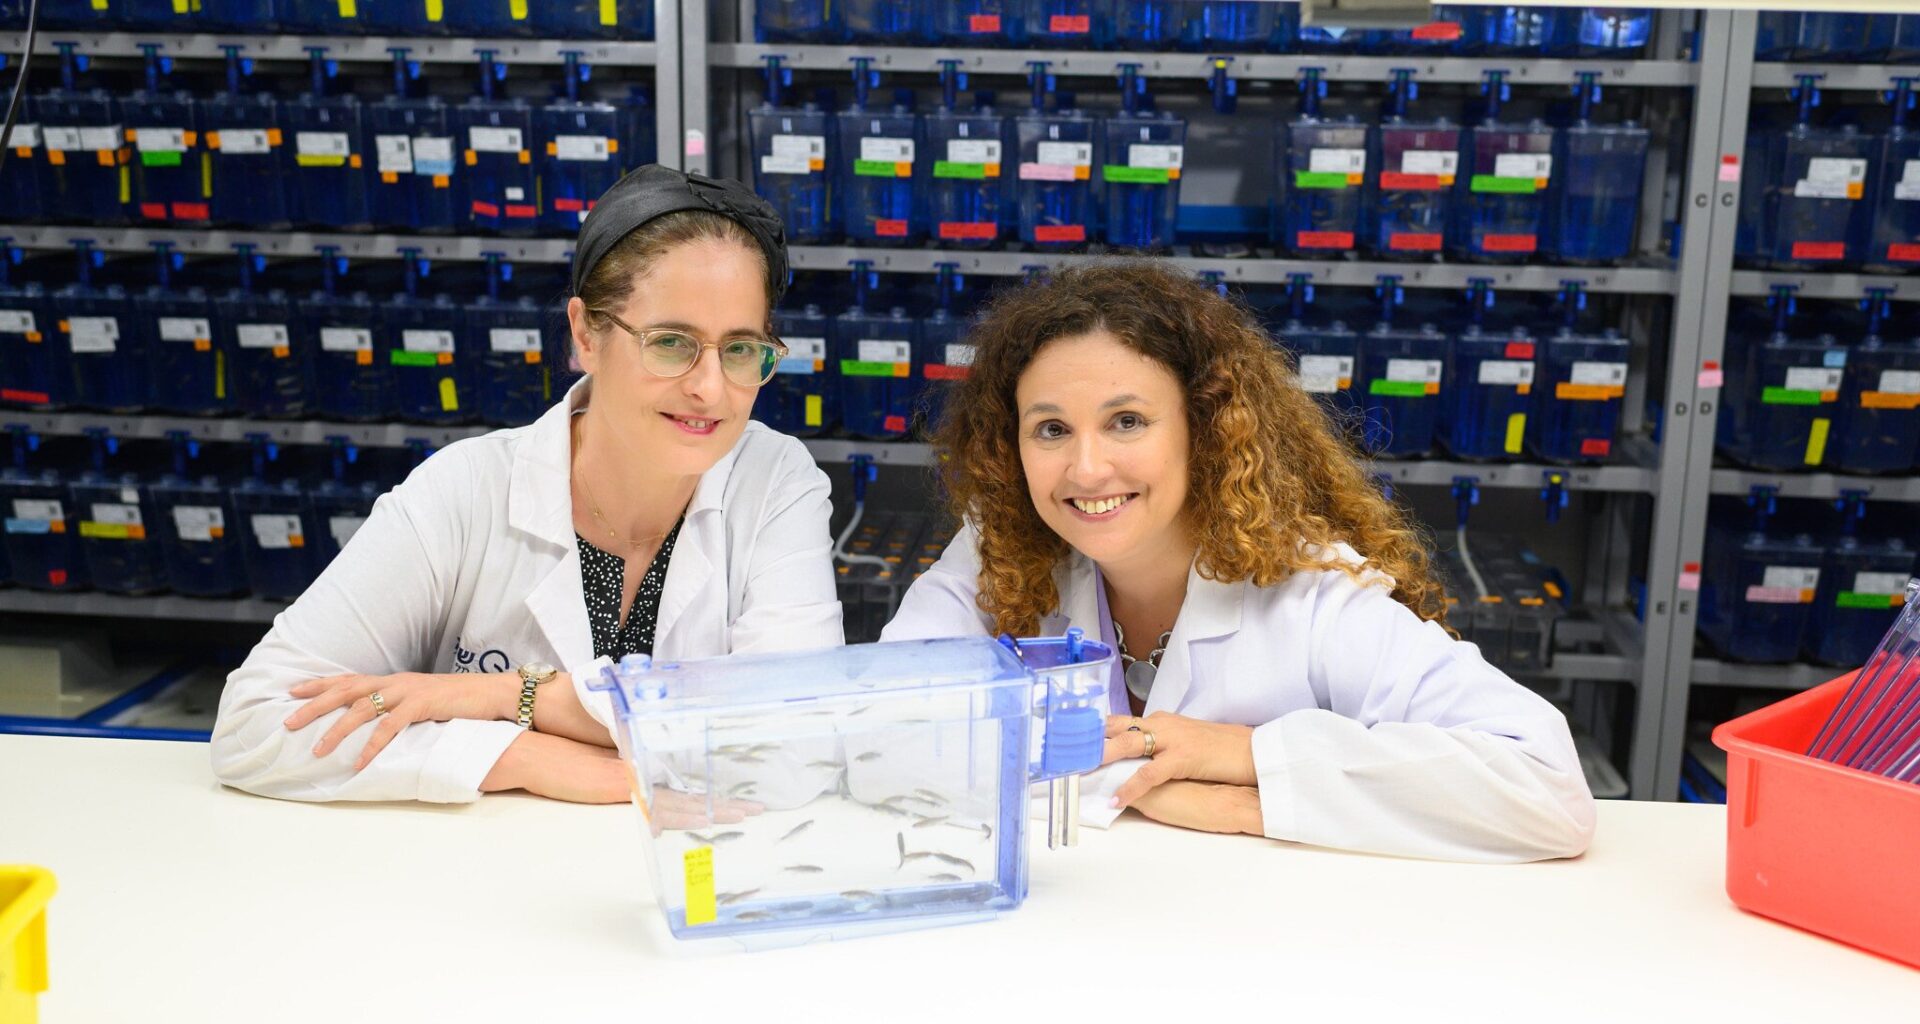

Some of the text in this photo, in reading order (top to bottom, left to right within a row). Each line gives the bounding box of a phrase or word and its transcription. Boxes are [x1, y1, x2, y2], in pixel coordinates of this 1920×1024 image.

[1695, 192, 1708, 208] C
[1721, 192, 1734, 208] C
[1675, 401, 1688, 416] D
[1700, 401, 1713, 415] D
[1655, 600, 1667, 615] E
[1678, 600, 1690, 615] E
